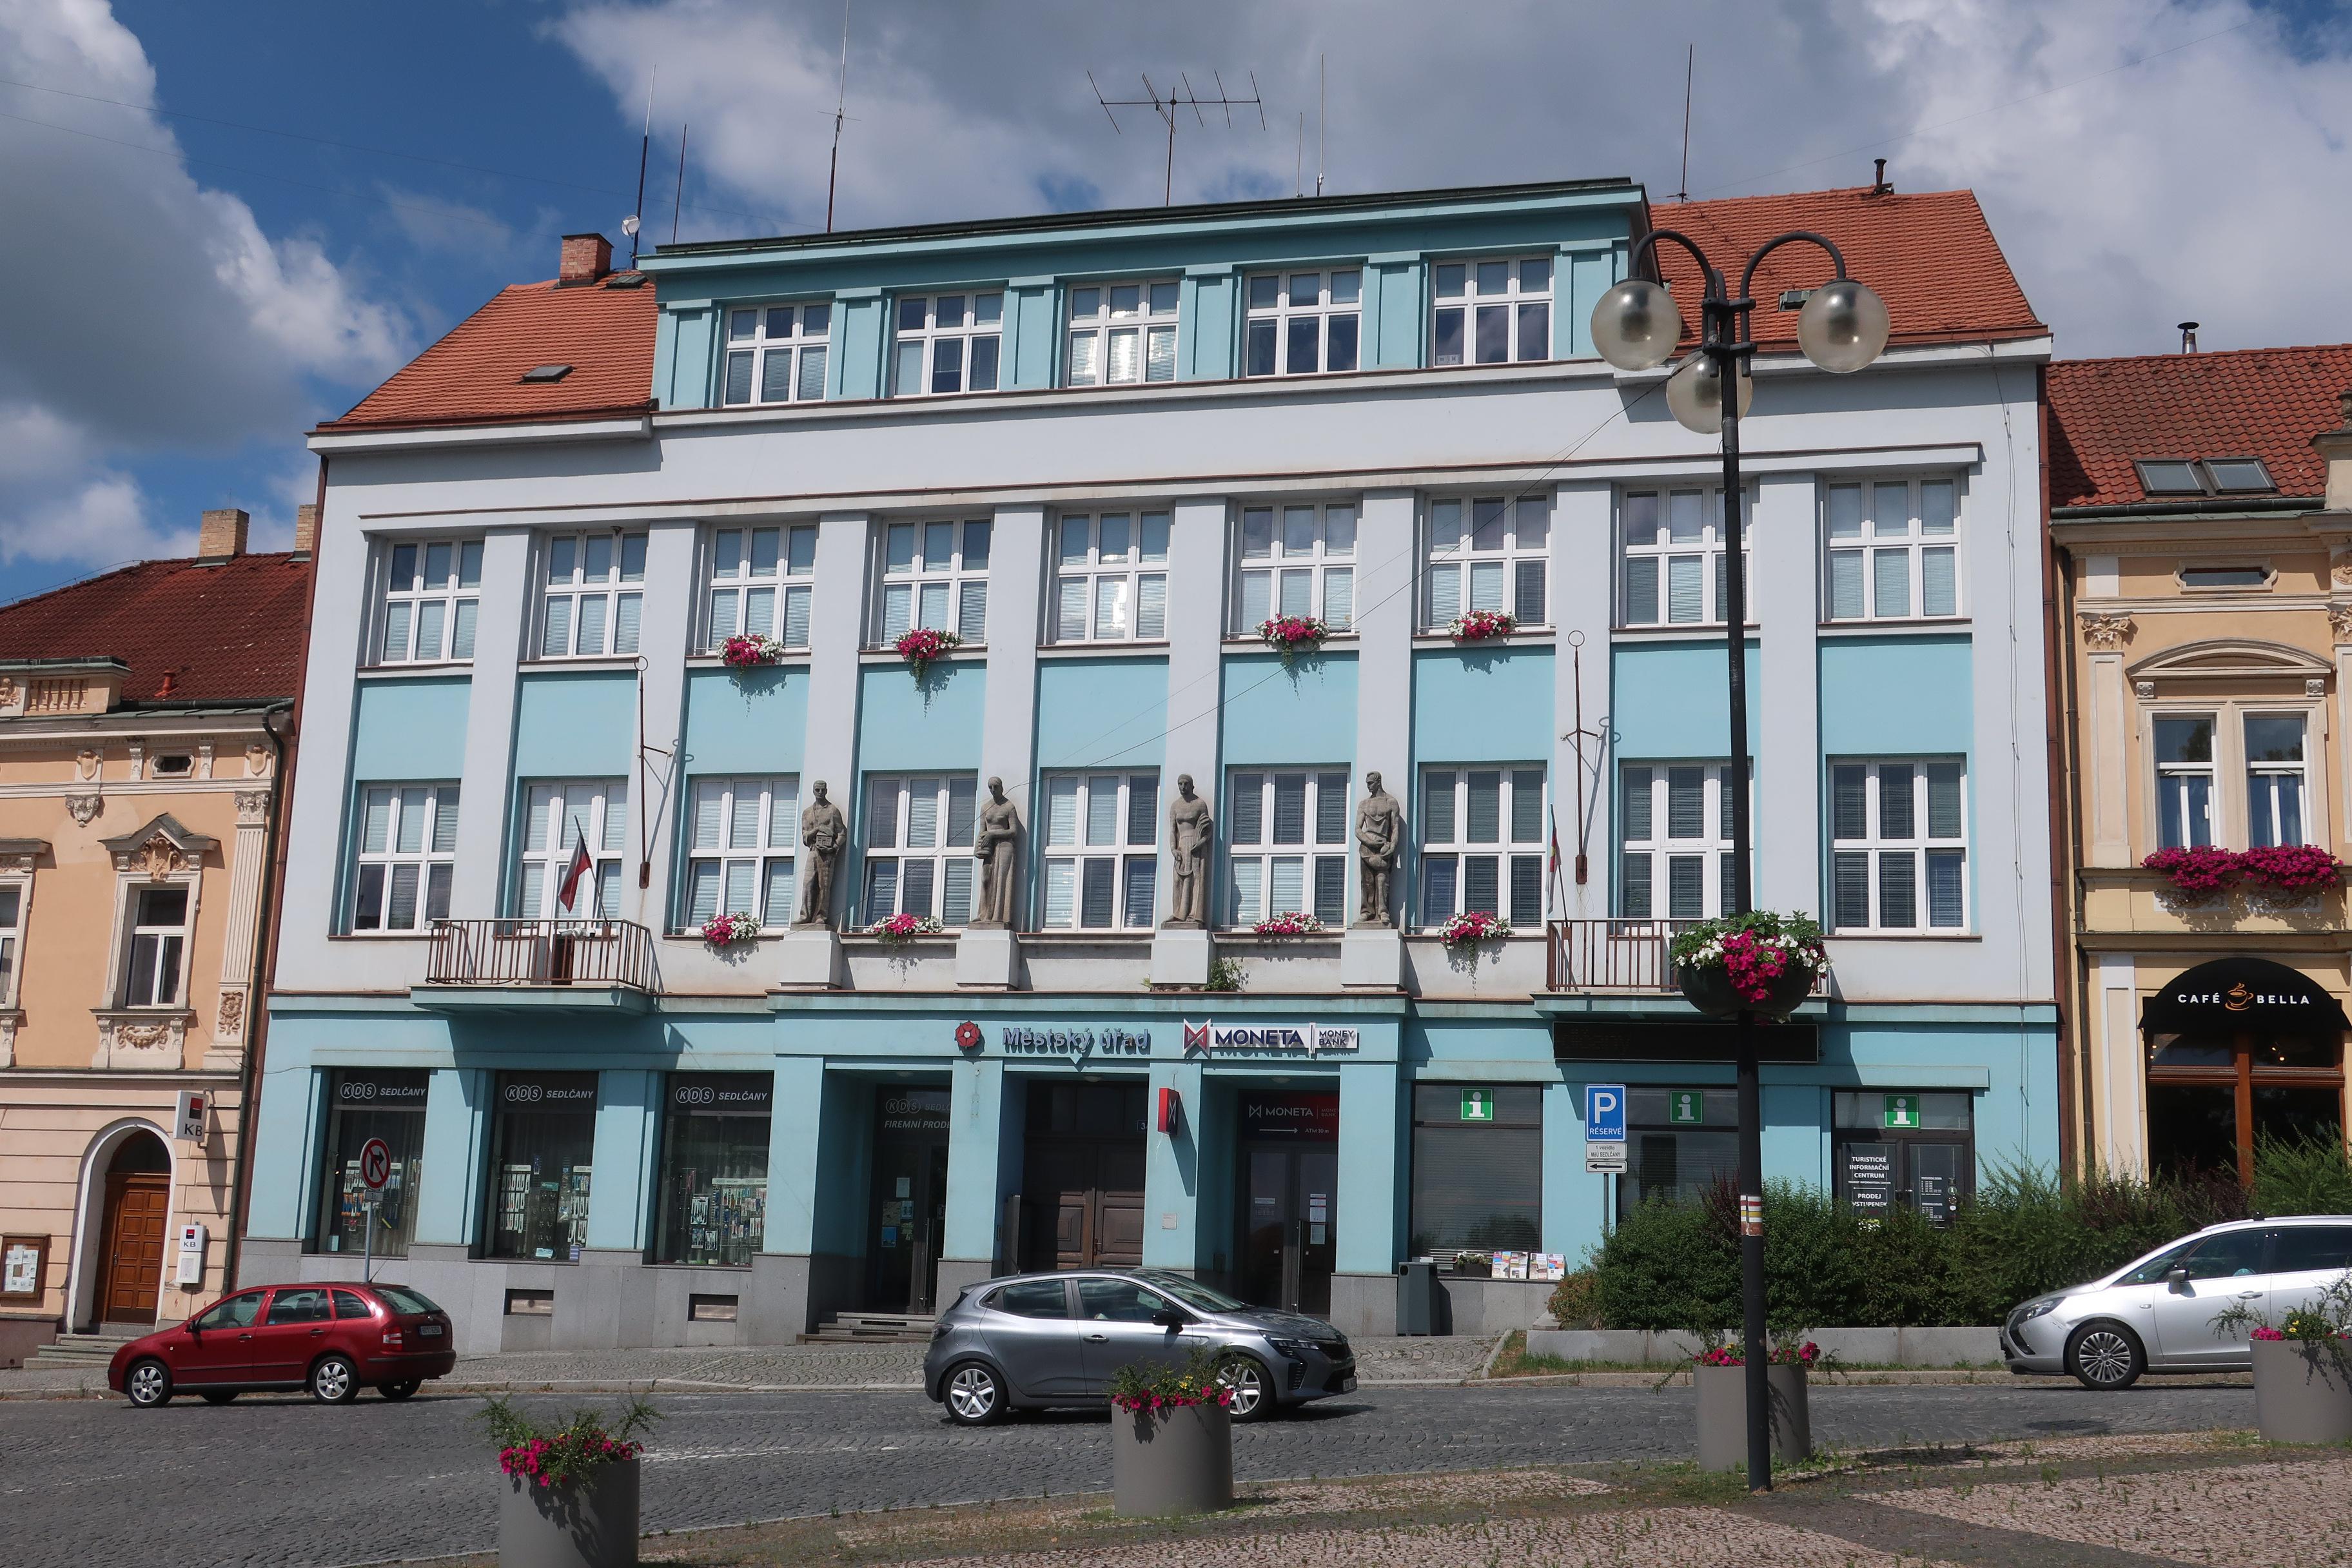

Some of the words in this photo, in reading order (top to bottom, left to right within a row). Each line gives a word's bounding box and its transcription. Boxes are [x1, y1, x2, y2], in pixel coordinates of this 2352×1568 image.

[2177, 992, 2220, 1003] CAFÉ
[2257, 995, 2310, 1004] BELLA
[1001, 1027, 1092, 1052] Městský
[1099, 1028, 1149, 1049] úřad
[1215, 1029, 1304, 1045] MONETA
[380, 1086, 426, 1096] SEDLČANY
[546, 1088, 594, 1099] SEDLČANY
[718, 1090, 768, 1101] SEDLČANY
[1266, 1107, 1314, 1117] MONETA
[1594, 1092, 1617, 1124] P
[884, 1119, 921, 1128] FIREMNÍ
[184, 1122, 203, 1137] KB
[1589, 1126, 1622, 1135] RÉSERVÉ
